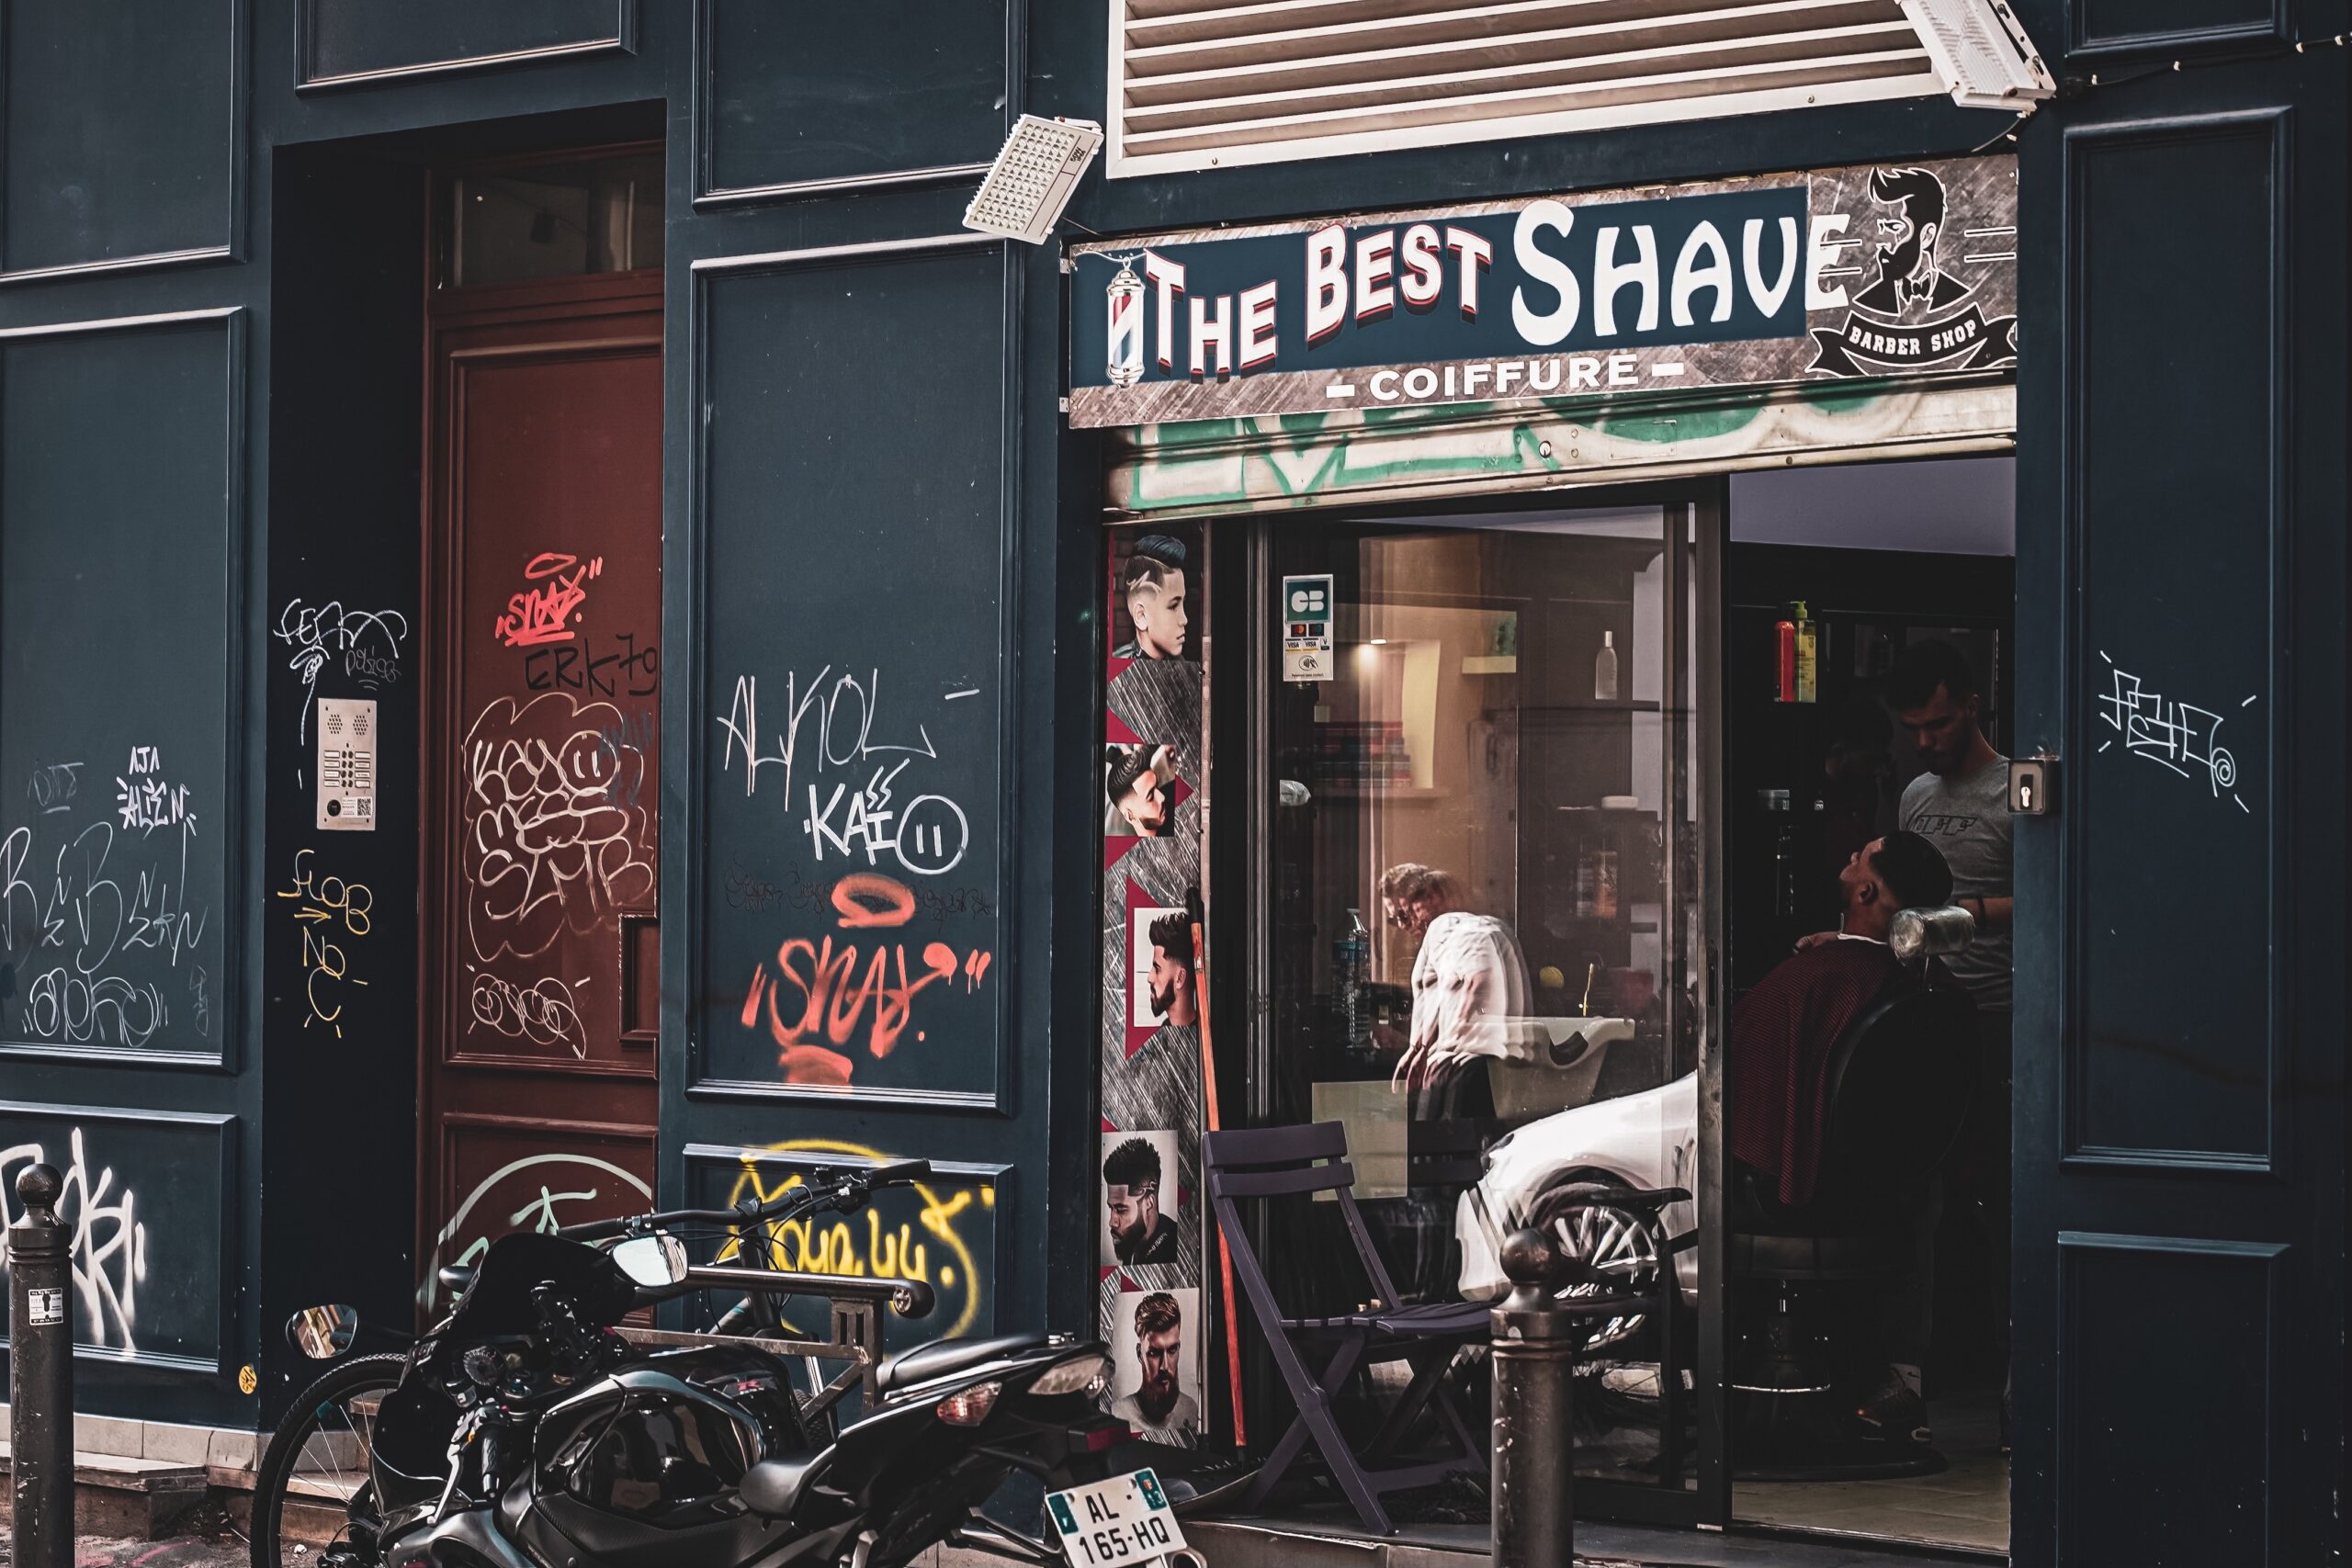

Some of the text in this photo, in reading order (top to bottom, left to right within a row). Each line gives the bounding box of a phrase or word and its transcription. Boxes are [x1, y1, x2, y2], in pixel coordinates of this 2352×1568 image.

[1144, 199, 1850, 382] THE BEST SHAVE
[1849, 319, 1976, 355] BARBER SHOP
[1369, 354, 1639, 401] COIFFURE
[1291, 590, 1325, 613] CB
[1085, 1492, 1120, 1524] AL
